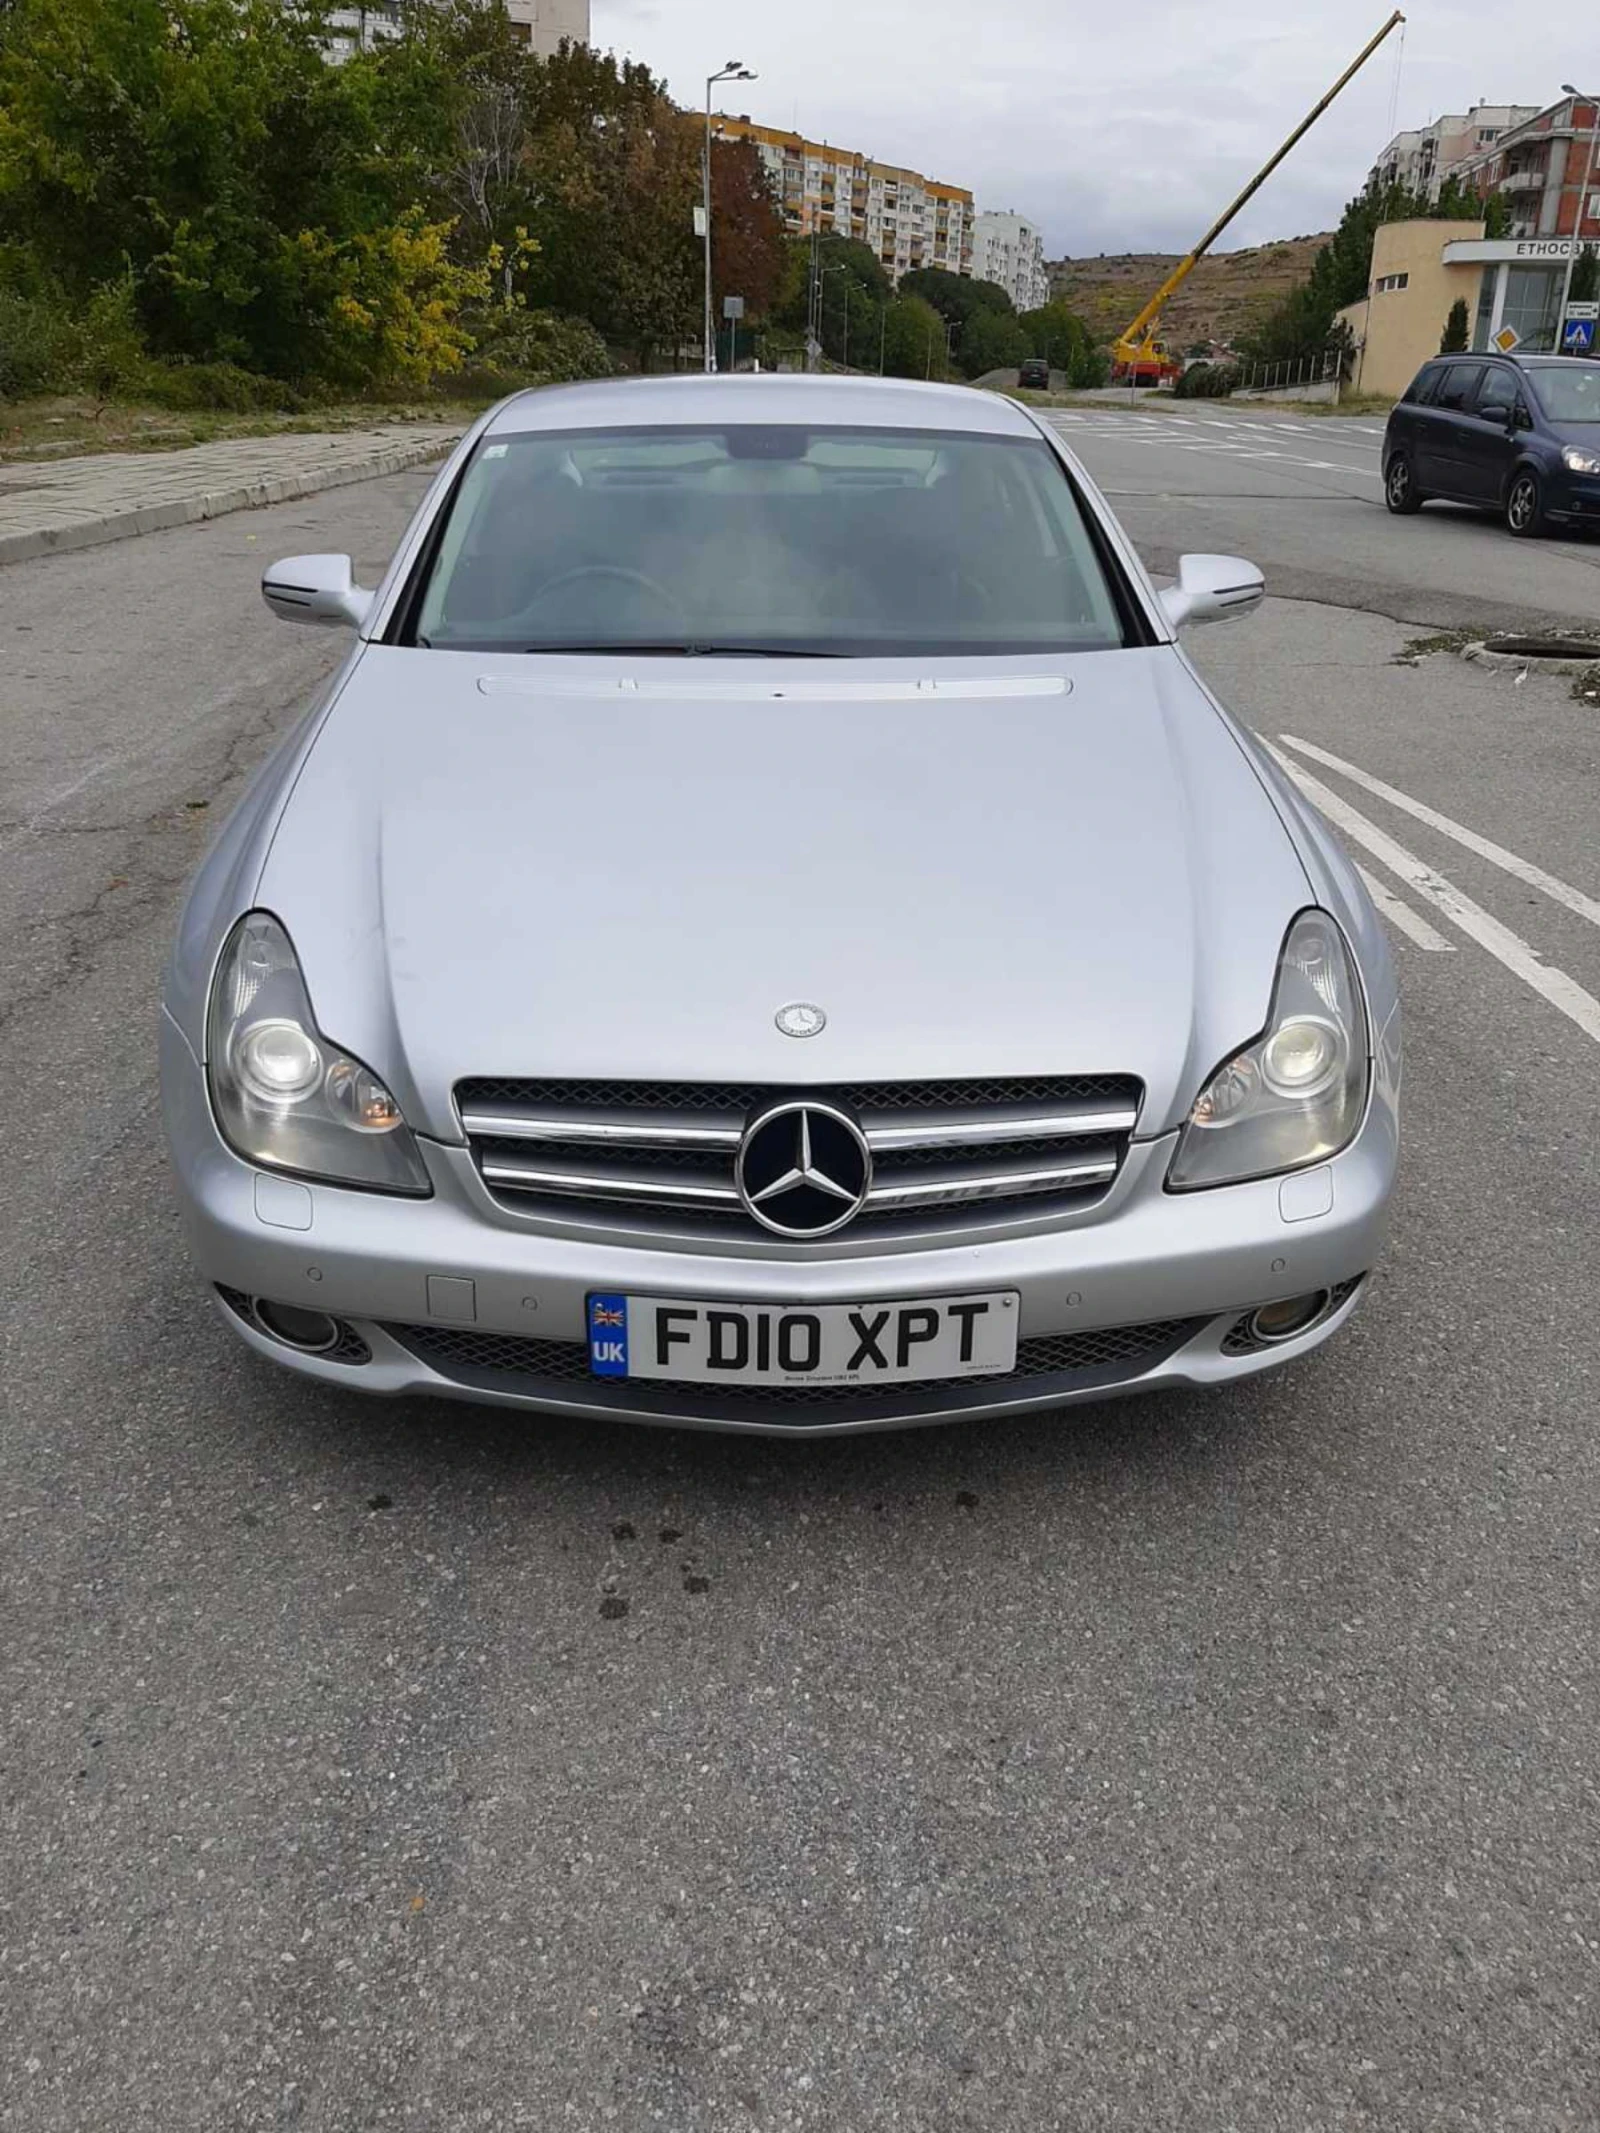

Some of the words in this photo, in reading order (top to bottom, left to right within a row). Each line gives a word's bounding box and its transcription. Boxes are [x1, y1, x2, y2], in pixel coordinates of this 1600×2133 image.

[593, 1341, 626, 1363] UK
[655, 1306, 821, 1373] FD10
[846, 1302, 989, 1371] XPT
